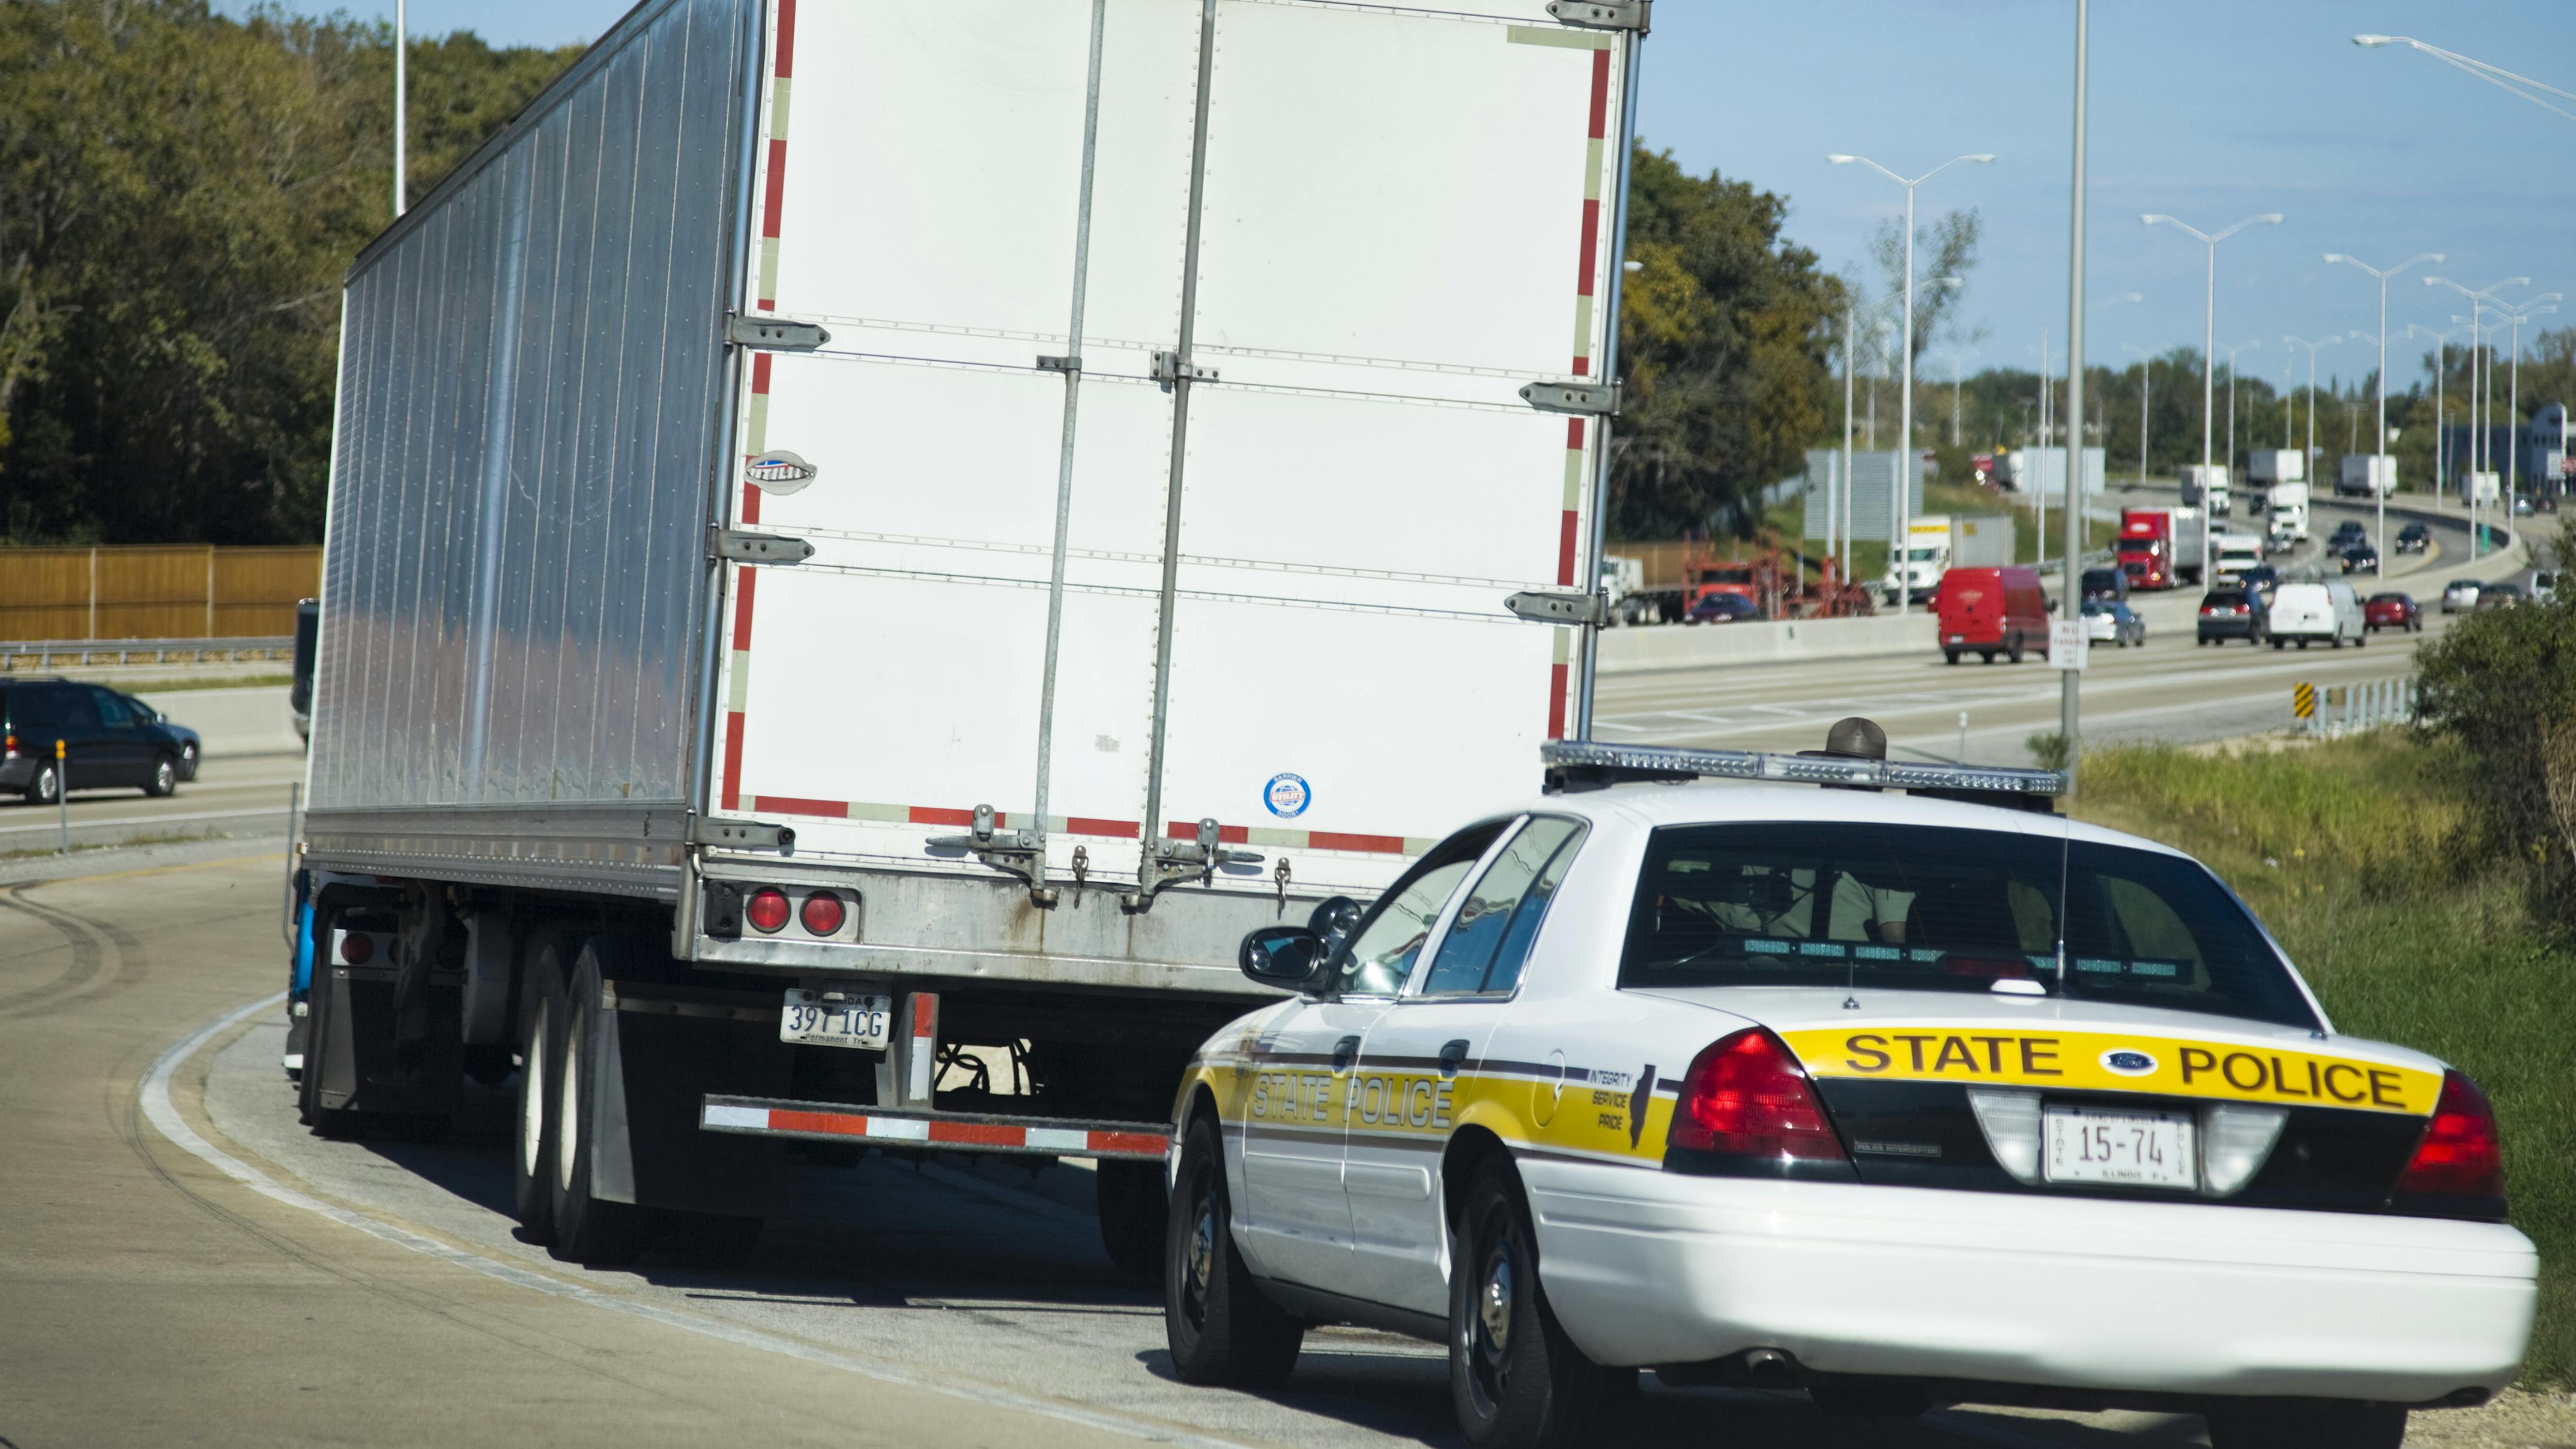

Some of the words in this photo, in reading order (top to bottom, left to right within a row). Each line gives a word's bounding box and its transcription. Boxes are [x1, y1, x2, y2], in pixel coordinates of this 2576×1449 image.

[839, 1009, 883, 1037] 1CG
[805, 1033, 847, 1044] Permanent
[1845, 1034, 2064, 1077] STATE
[1589, 1069, 1633, 1088] INTEGRITY
[2179, 1047, 2407, 1110] POLICE
[1254, 1072, 1332, 1122] STATE
[1343, 1075, 1454, 1128] POLICE
[1592, 1091, 1628, 1109] SERVICE
[1598, 1113, 1623, 1131] PRIDE
[2079, 1125, 2162, 1164] 15-74
